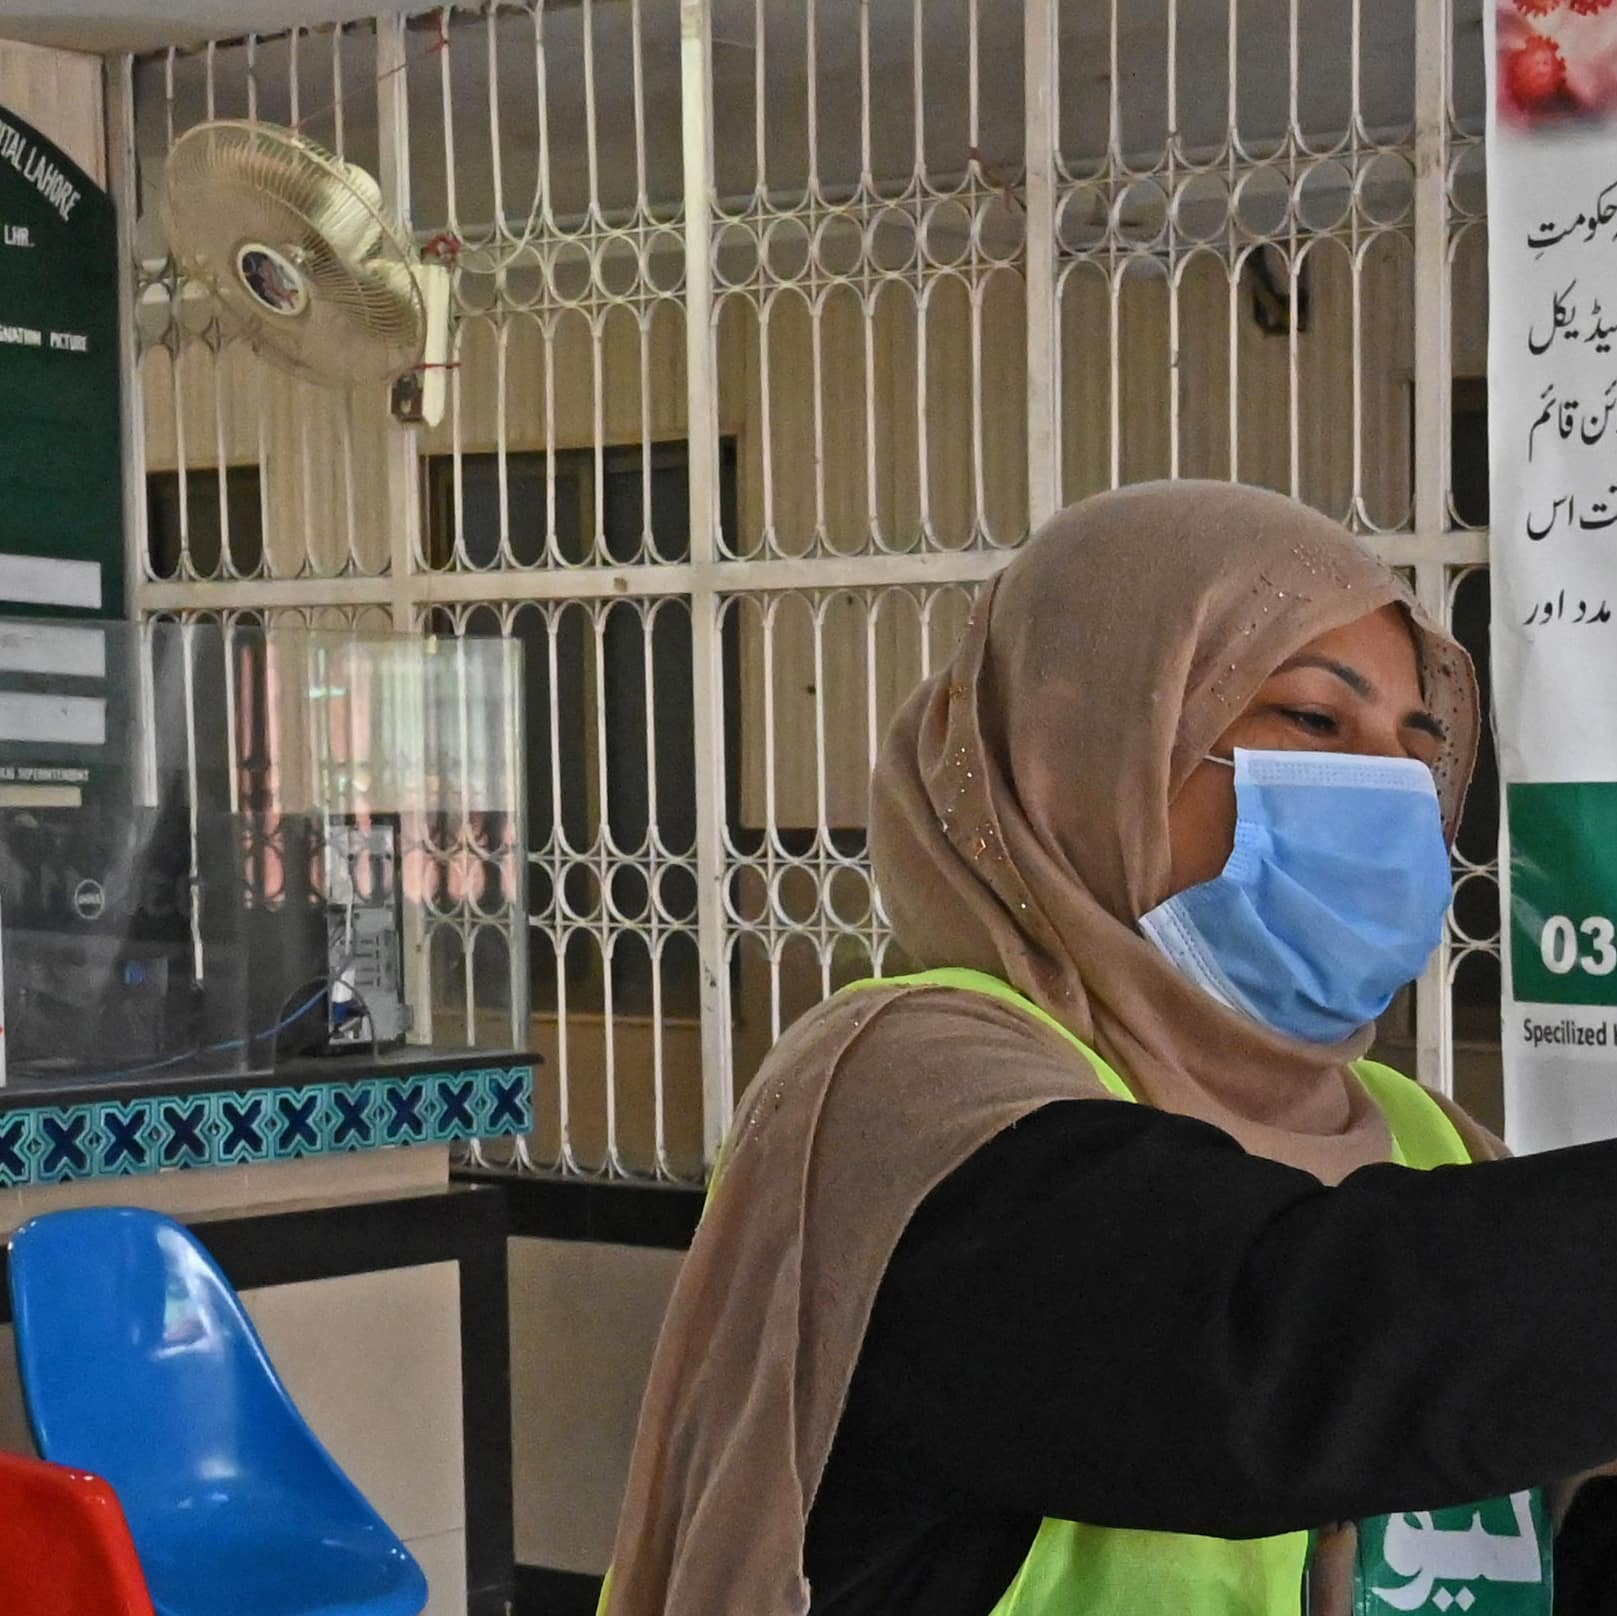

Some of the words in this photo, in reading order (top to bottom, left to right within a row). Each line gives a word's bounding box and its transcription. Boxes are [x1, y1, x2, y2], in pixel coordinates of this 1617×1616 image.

[23, 147, 81, 222] LAHORE
[1527, 384, 1580, 462] قائم
[1526, 495, 1574, 541] اس
[1522, 588, 1565, 626] اور
[1571, 588, 1611, 625] مدد
[1522, 1017, 1608, 1052] Specilized
